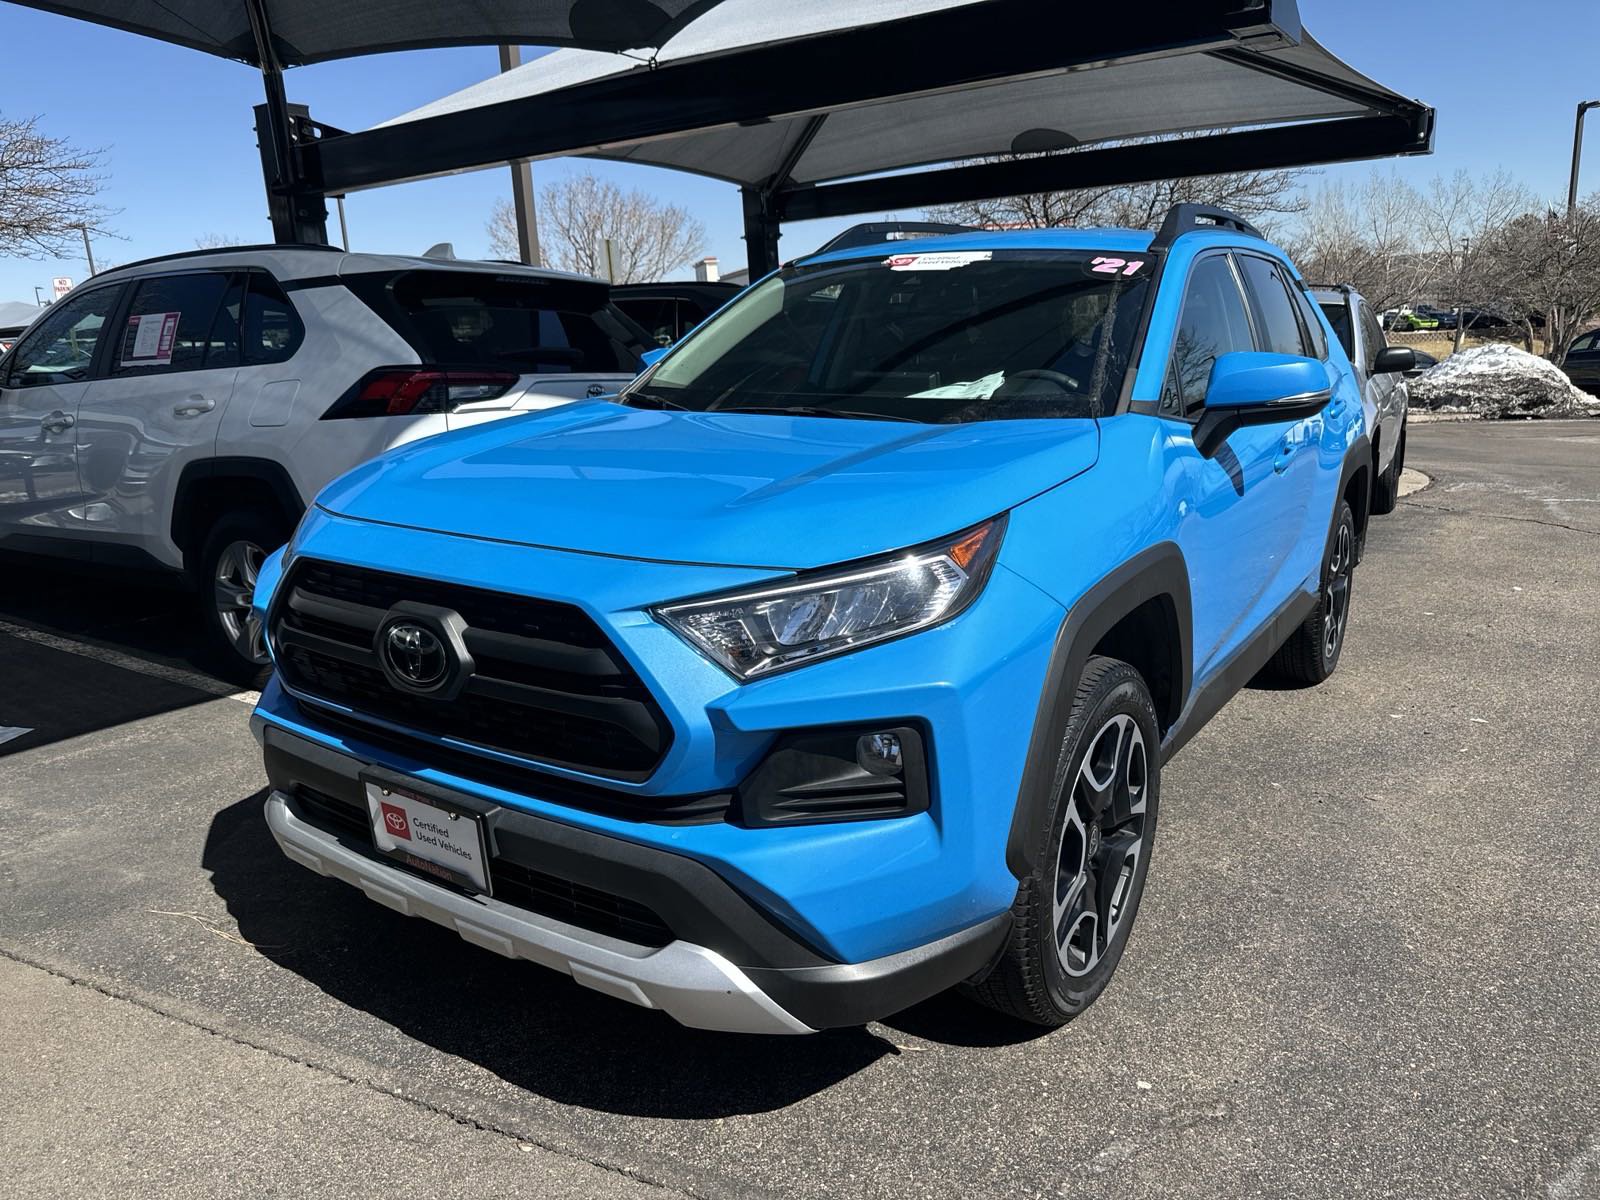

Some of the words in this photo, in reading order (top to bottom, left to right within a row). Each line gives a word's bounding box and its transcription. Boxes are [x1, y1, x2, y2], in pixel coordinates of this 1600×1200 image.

[1091, 256, 1144, 276] '21
[413, 817, 449, 838] Certified
[416, 830, 438, 846] Used
[438, 841, 472, 860] Vehicles
[406, 854, 453, 881] AutoNation
